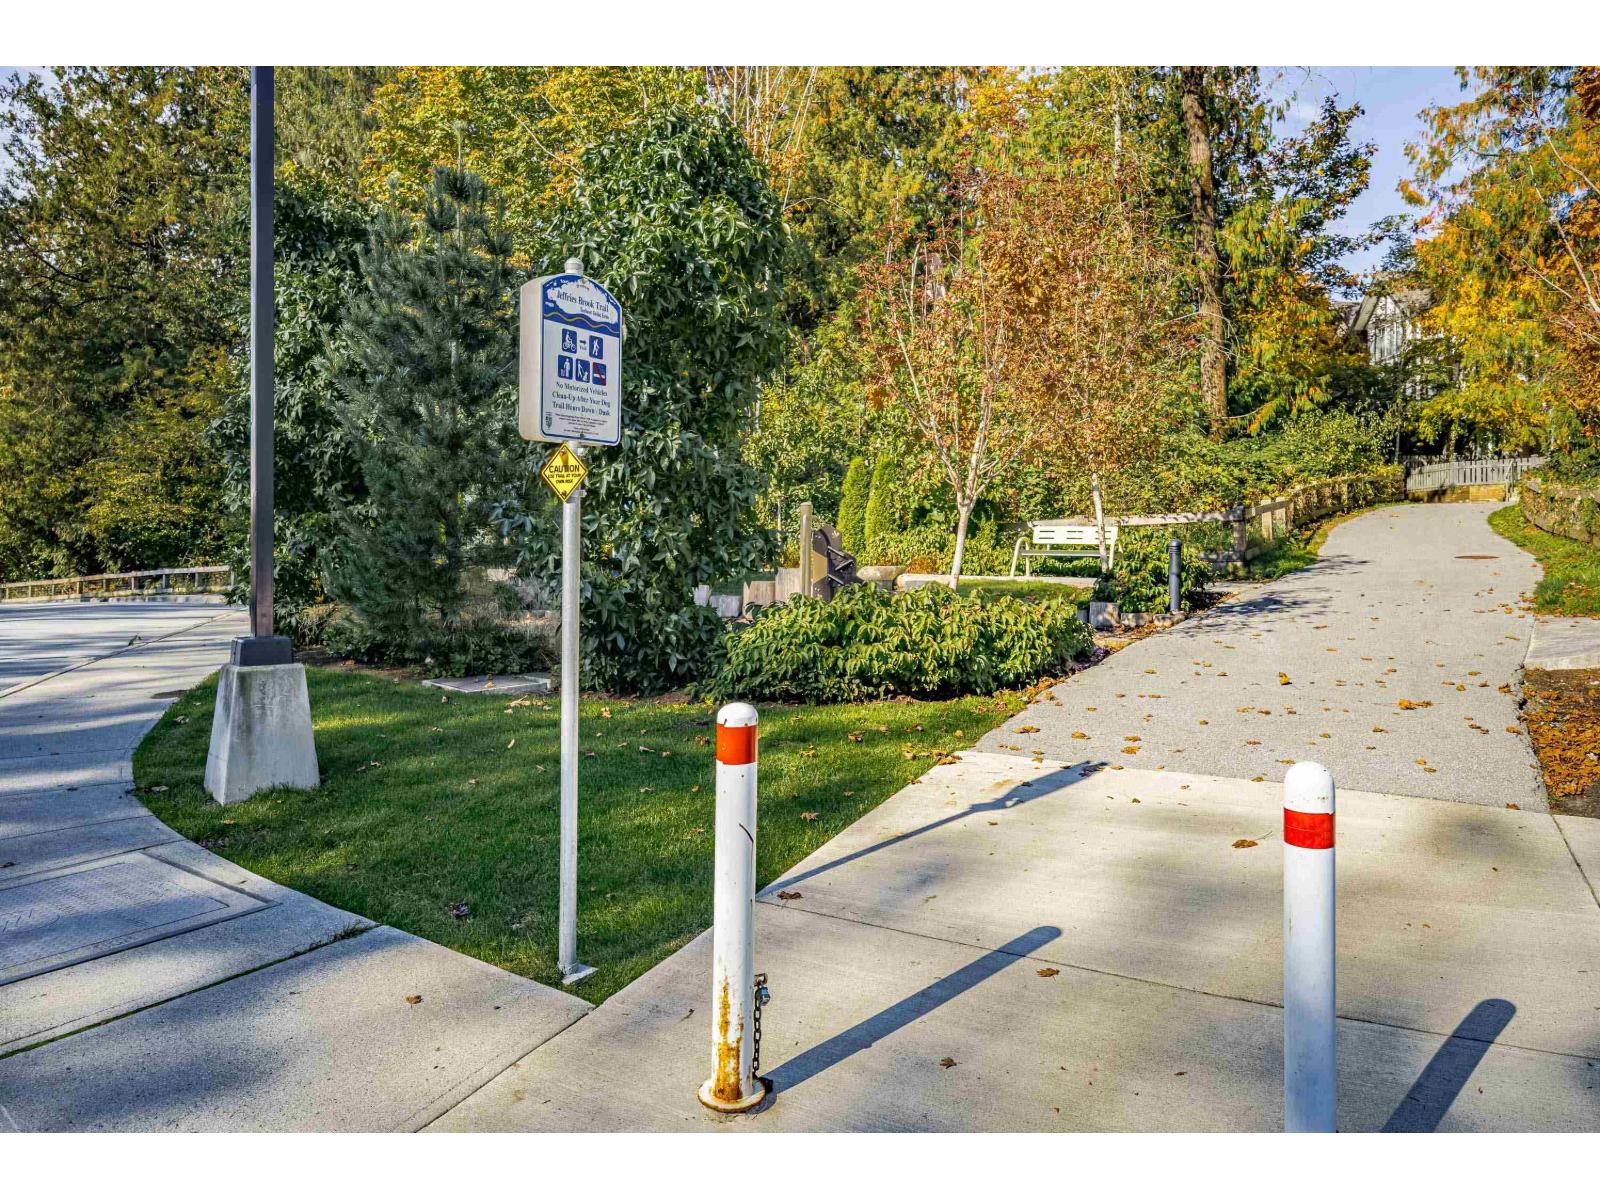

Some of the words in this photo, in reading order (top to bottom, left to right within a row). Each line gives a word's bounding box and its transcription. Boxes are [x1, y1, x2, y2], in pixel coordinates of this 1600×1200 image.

[578, 296, 594, 308] Brook
[596, 302, 609, 312] Trail
[564, 382, 588, 393] Motorized
[566, 403, 580, 411] Hours
[548, 465, 580, 473] CAUTION
